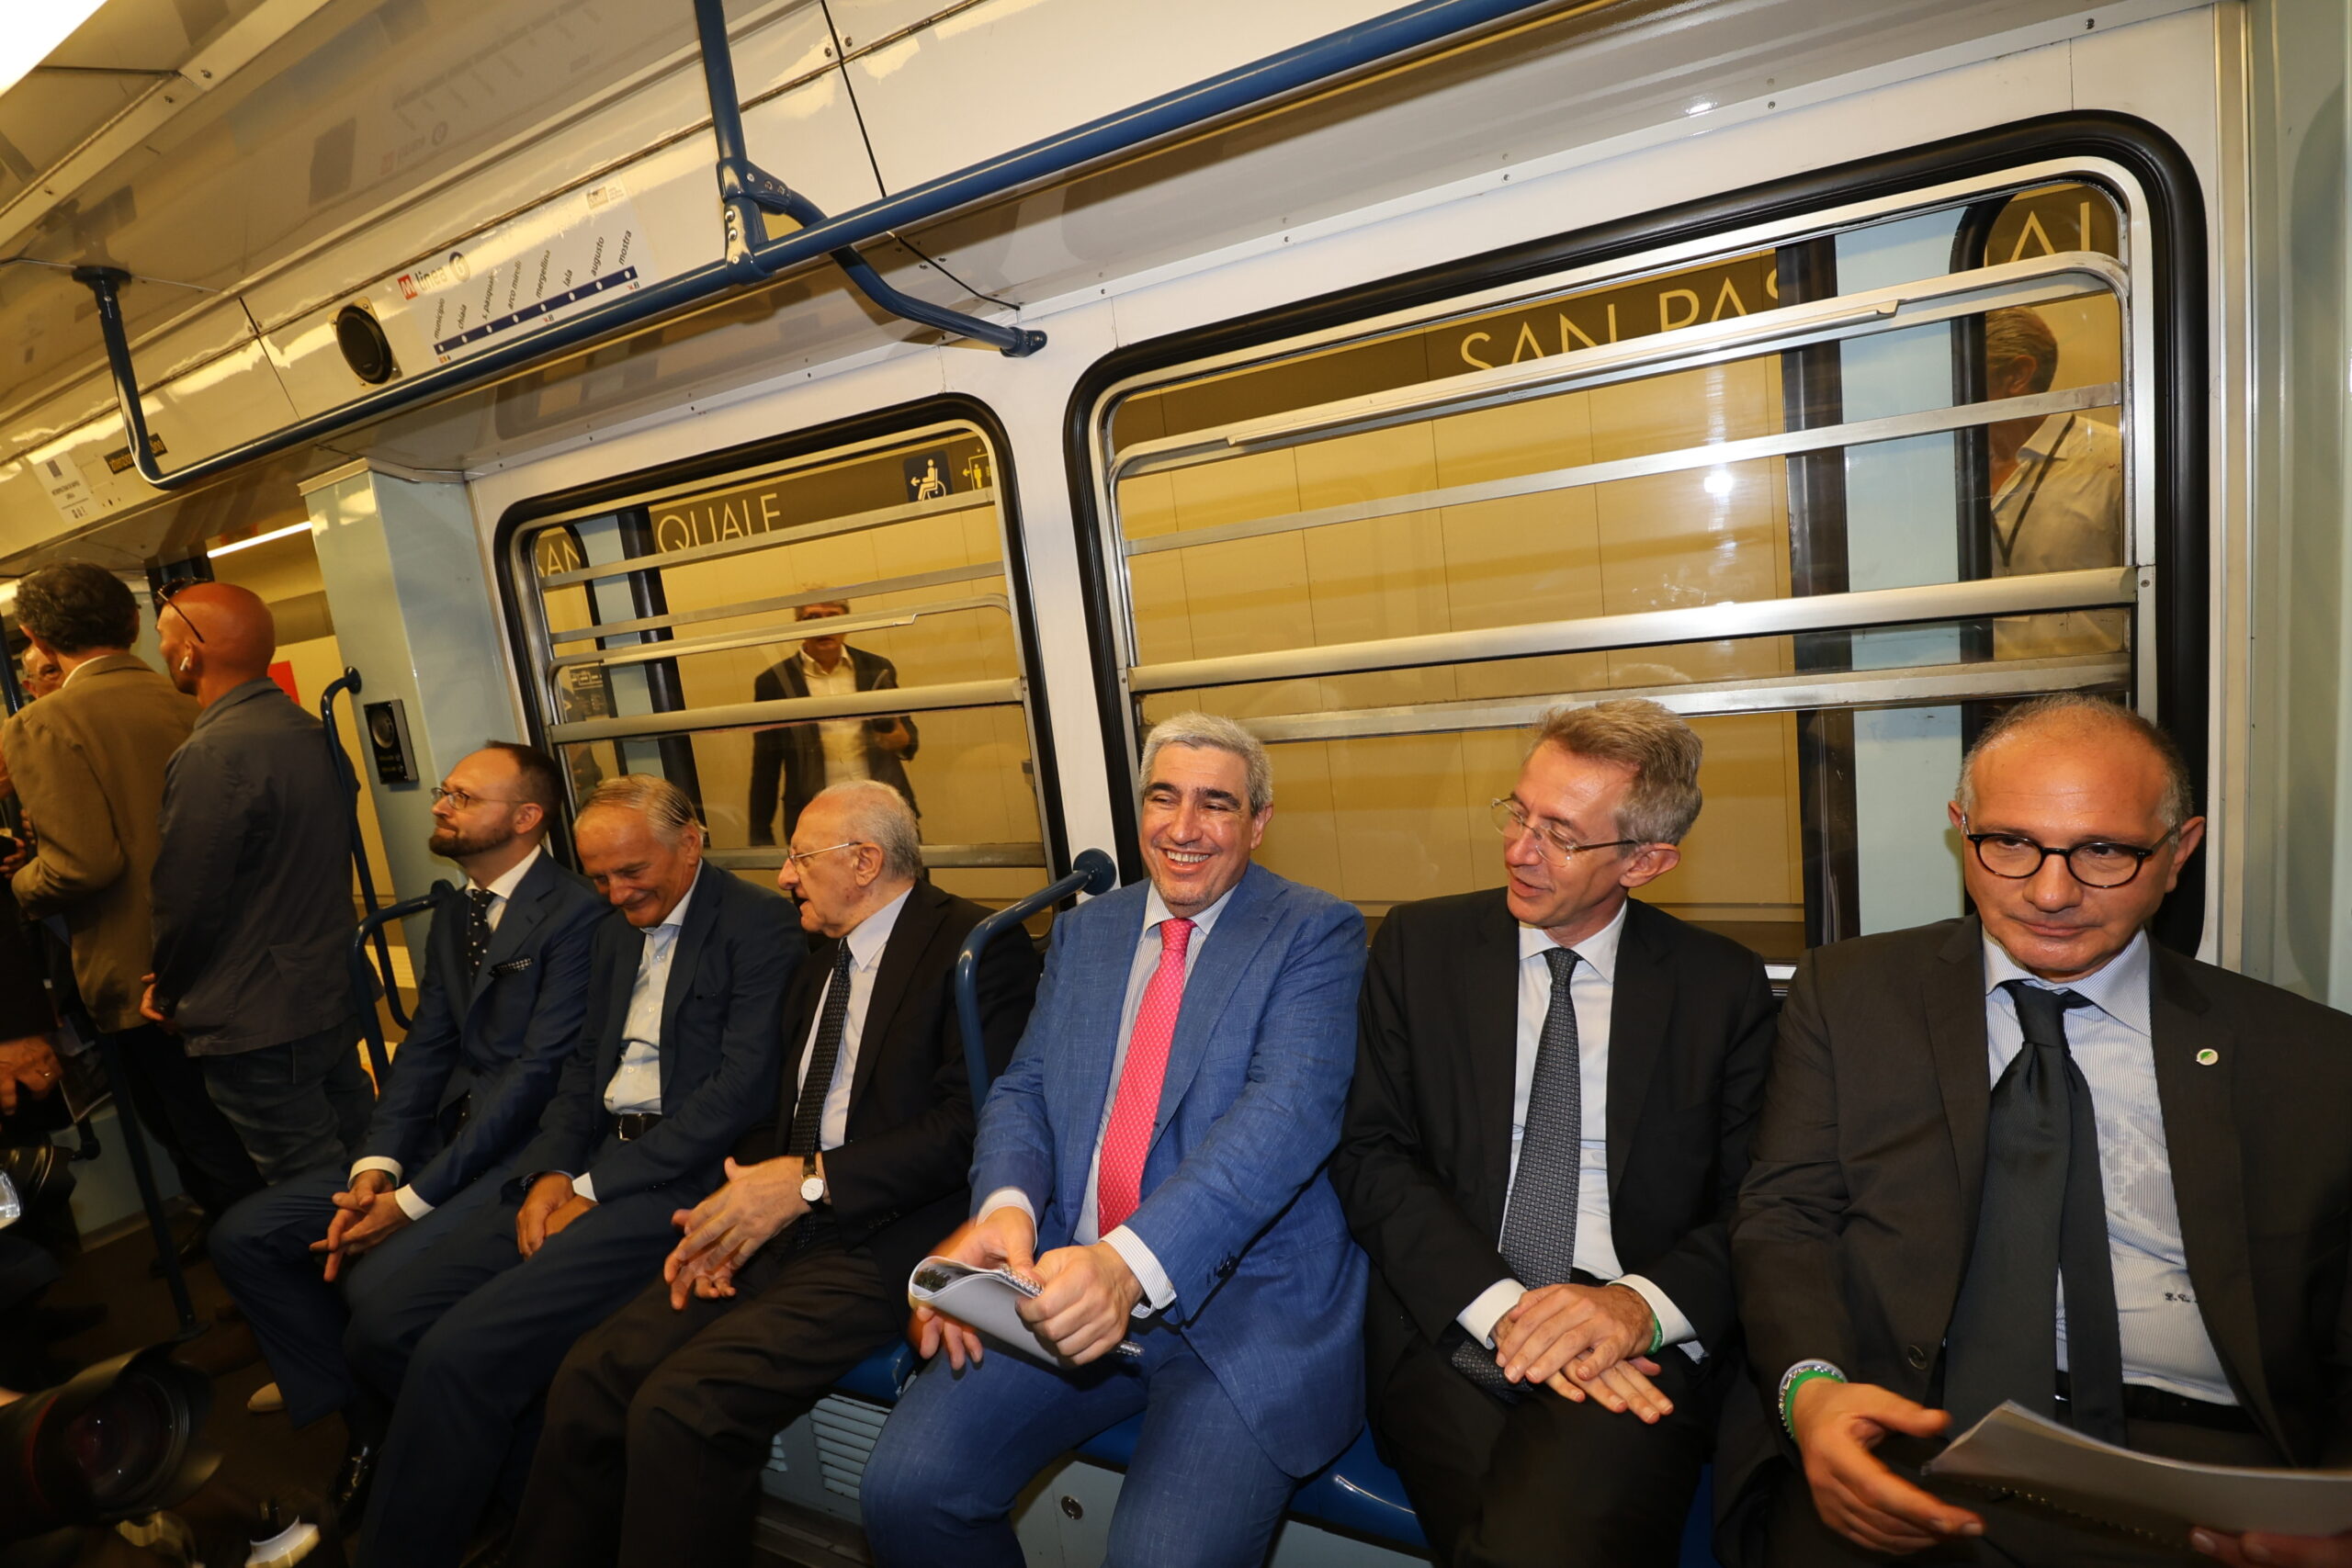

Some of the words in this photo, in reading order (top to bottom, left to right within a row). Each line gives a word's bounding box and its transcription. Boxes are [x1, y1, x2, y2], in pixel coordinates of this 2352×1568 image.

[590, 236, 605, 276] augusto
[618, 230, 632, 265] mostra
[414, 270, 447, 291] linea
[536, 250, 550, 299] mergellina
[507, 288, 516, 310] arco
[434, 298, 445, 340] municipio
